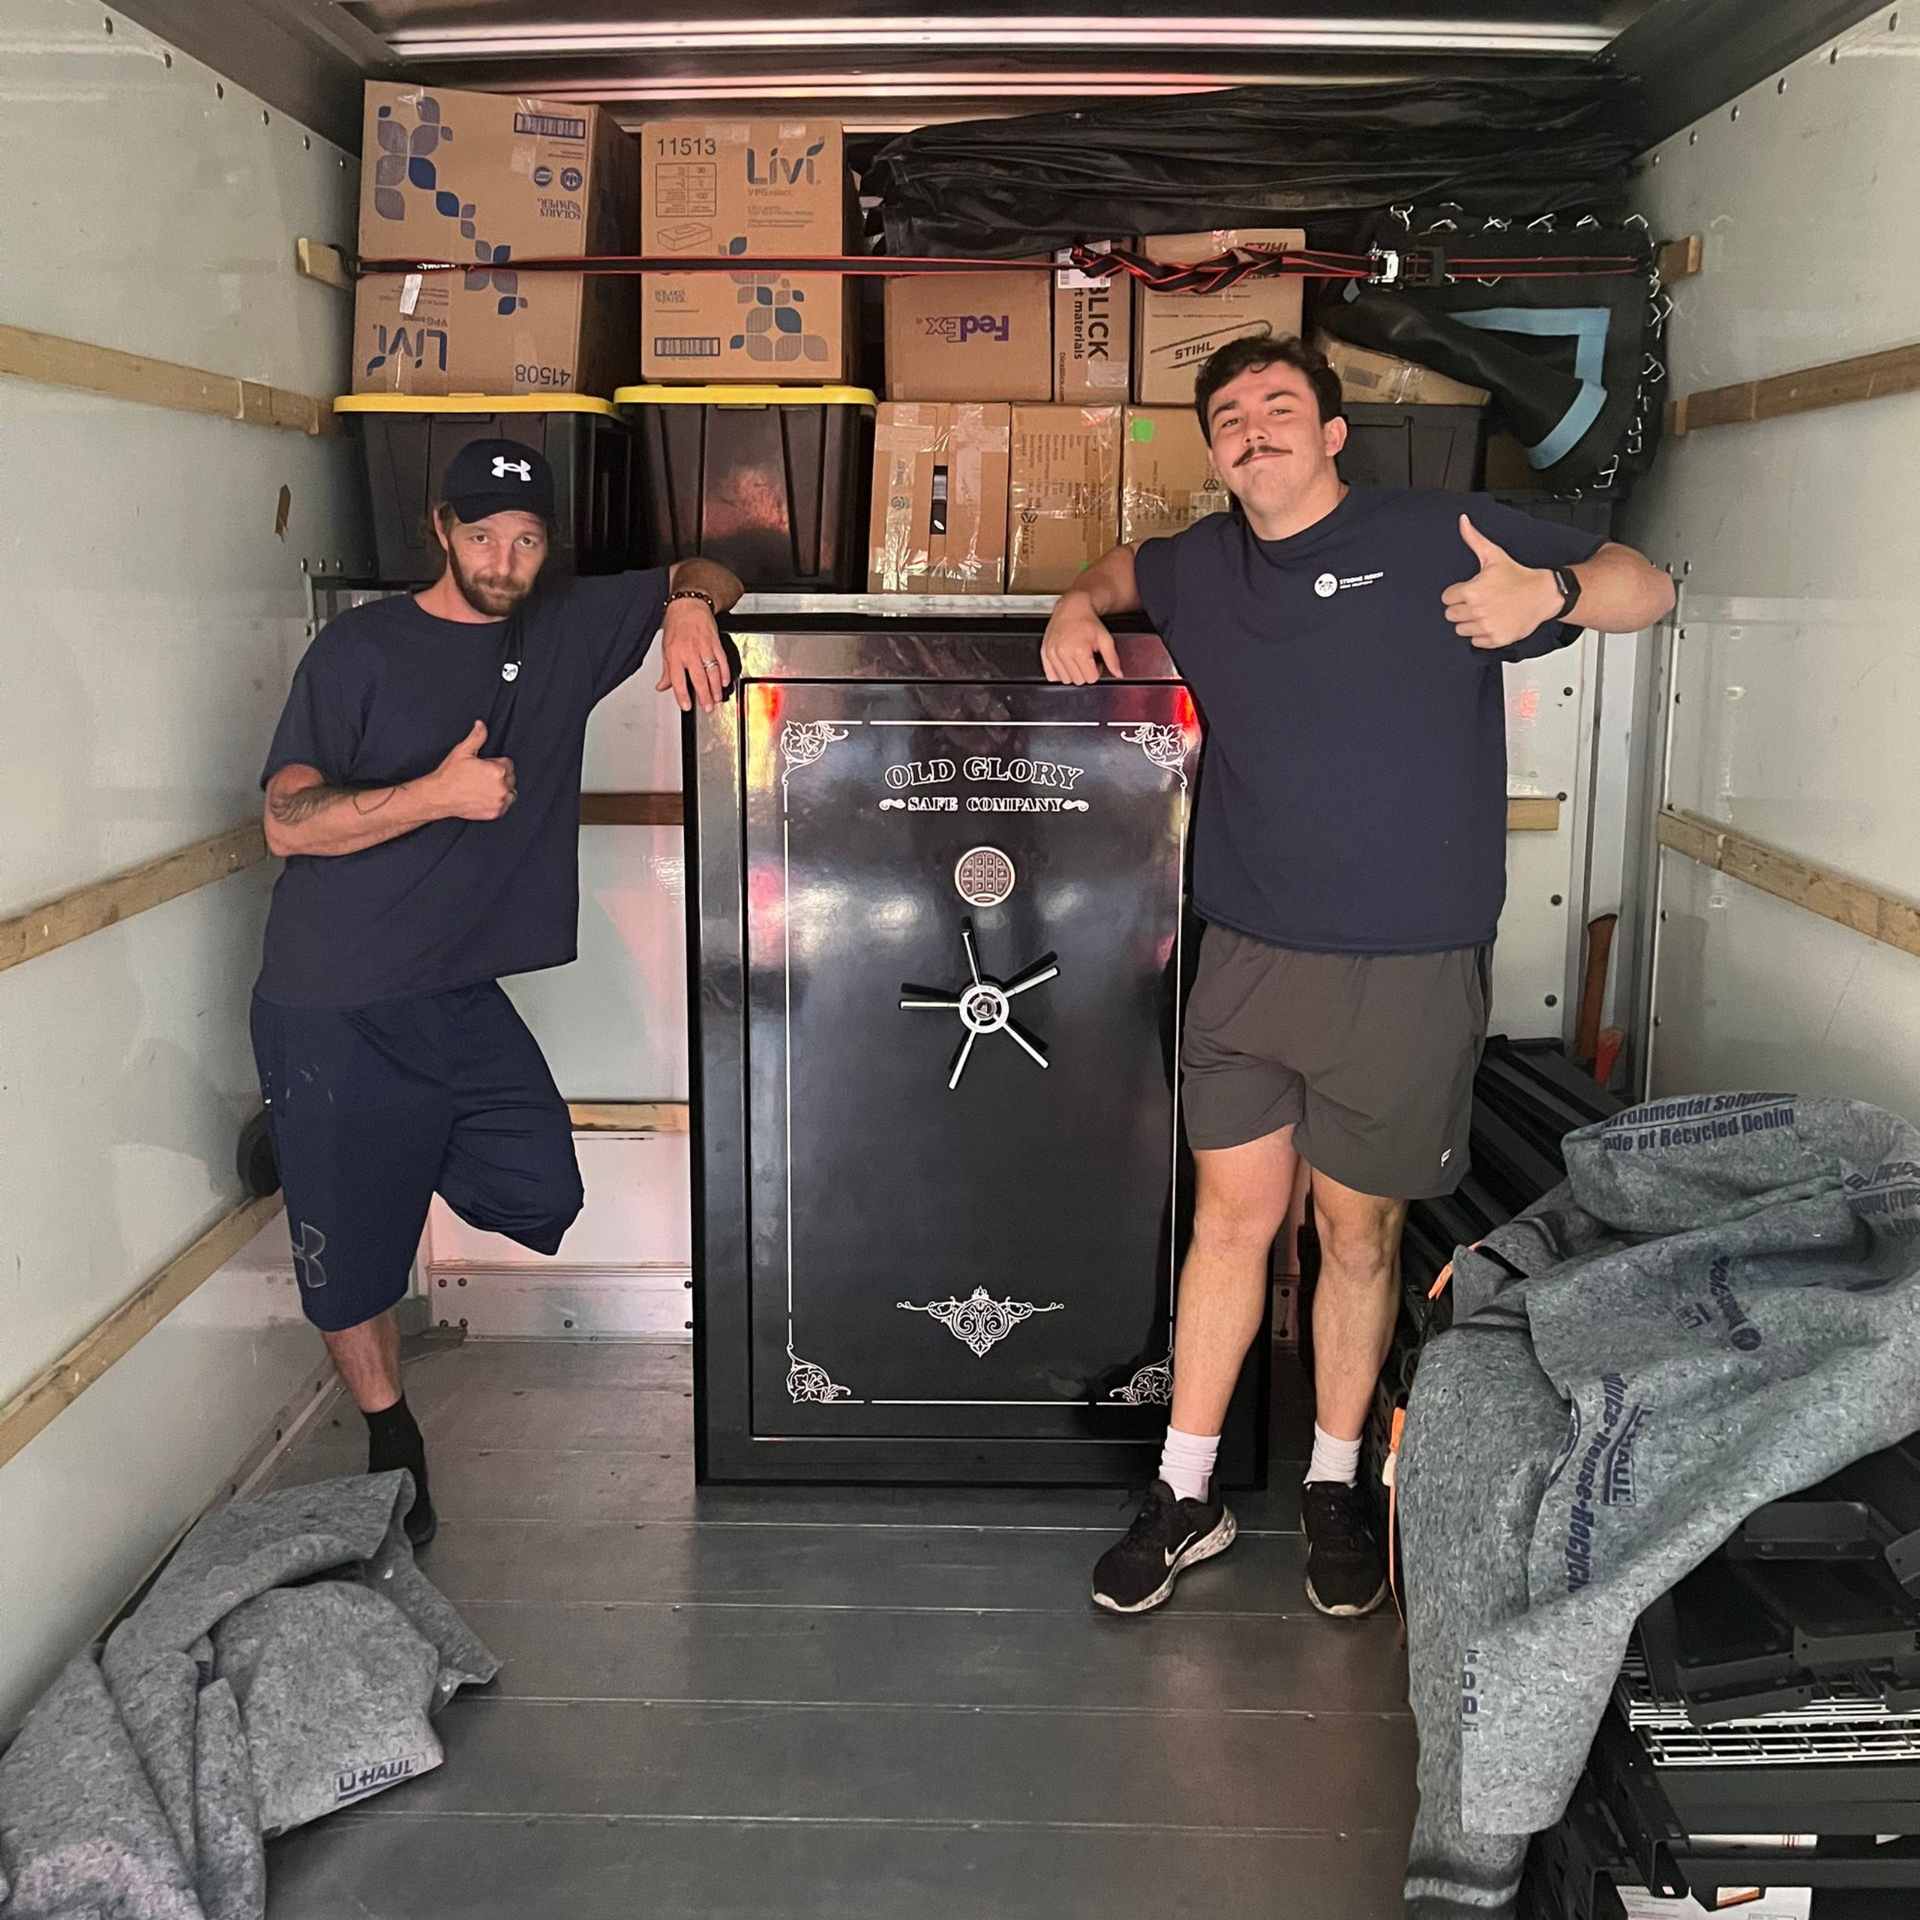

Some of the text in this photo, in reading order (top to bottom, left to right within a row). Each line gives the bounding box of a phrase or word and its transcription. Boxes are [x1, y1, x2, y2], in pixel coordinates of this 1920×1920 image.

[657, 137, 716, 156] 11513
[747, 136, 825, 185] Livi
[540, 197, 570, 209] PAPER
[748, 188, 768, 196] VPG
[539, 207, 581, 220] SOLARIS
[427, 317, 448, 327] VPG
[926, 315, 1010, 344] FedEx
[1073, 288, 1085, 361] rt materials
[366, 326, 448, 376] Livi
[1174, 341, 1215, 361] STIHL
[515, 364, 571, 388] 41508
[884, 756, 1084, 790] OLD GLORY
[908, 797, 1064, 812] SAFE COMPANY
[1602, 1107, 1795, 1152] ade of Recycled Denim
[339, 1758, 416, 1793] U-HAUL
